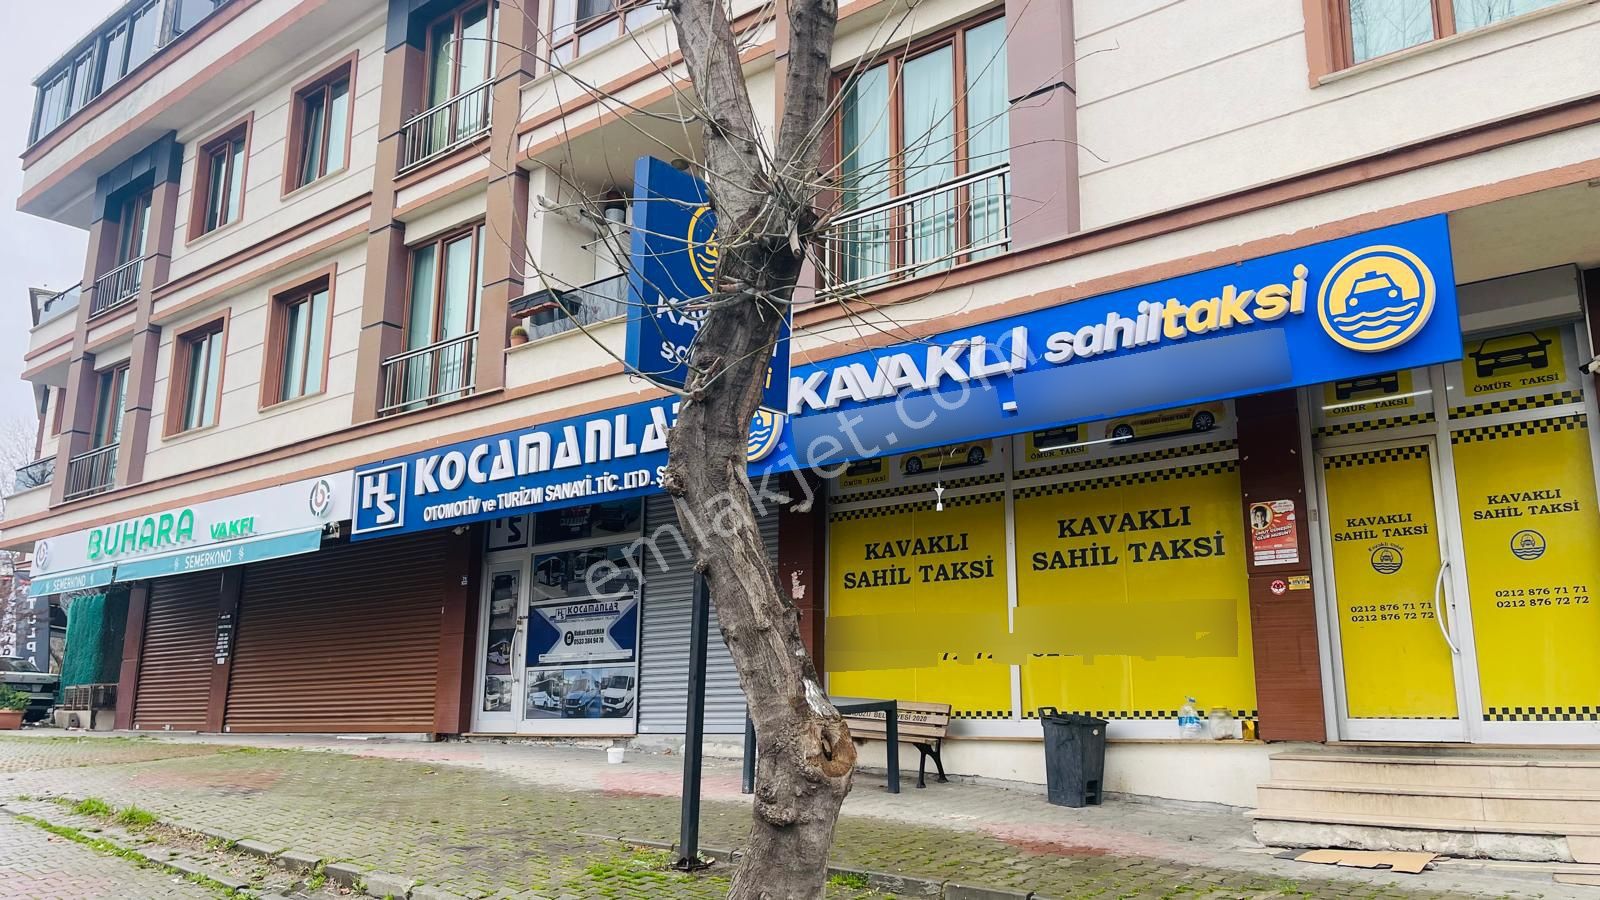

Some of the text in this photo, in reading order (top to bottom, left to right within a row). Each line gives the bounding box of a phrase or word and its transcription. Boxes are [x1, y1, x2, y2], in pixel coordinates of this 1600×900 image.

[788, 325, 1029, 415] KAVAKLI
[1473, 373, 1560, 393] ÖMÜR TAKSİ
[423, 495, 481, 522] OTOMOTİV
[482, 498, 496, 512] ve
[498, 486, 542, 510] TURİZM
[1486, 489, 1561, 505] KAVAKLI
[1473, 499, 1580, 520] SAHİL TAKSİ
[1057, 506, 1192, 539] KAVAKLI
[1346, 513, 1413, 528] KAVAKLI
[88, 509, 255, 558] BUHARA VAKFI
[1334, 523, 1429, 542] SAHİL TAKSİ
[864, 533, 969, 560] KAVAKLI
[1032, 530, 1225, 572] SAHİL TAKSİ
[185, 549, 232, 569] SEMERKAND
[844, 555, 994, 589] SAHİL TAKSİ
[1495, 585, 1588, 598] 0212 876 71 71
[567, 602, 619, 614] KOCAMANLAR
[1350, 604, 1377, 613] 0212
[1379, 603, 1400, 612] 876
[1496, 596, 1590, 608] 0212 876 72 72
[1351, 611, 1434, 622] 0212 876 72 72
